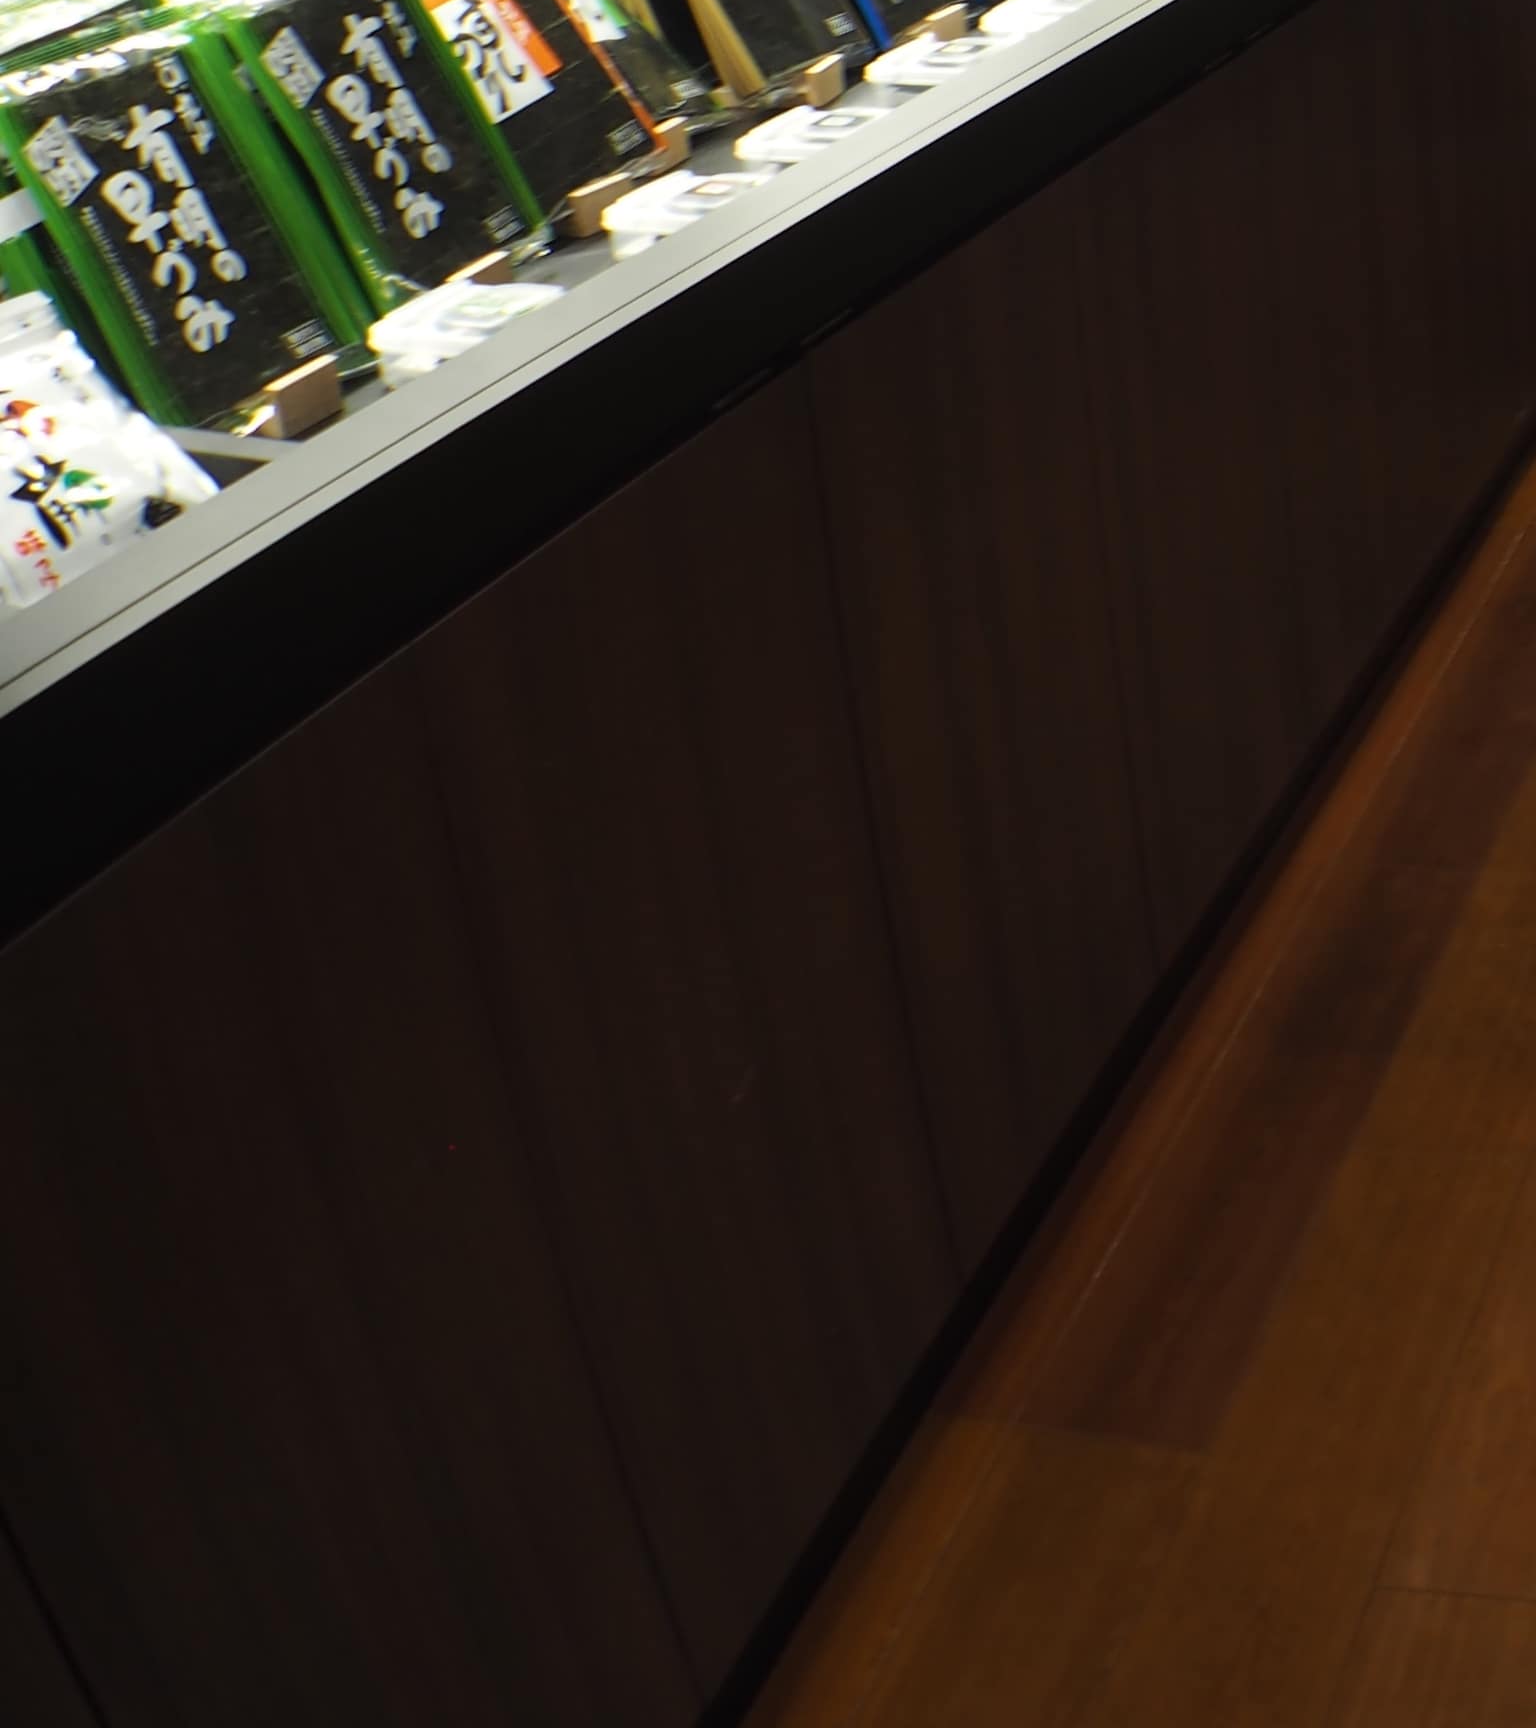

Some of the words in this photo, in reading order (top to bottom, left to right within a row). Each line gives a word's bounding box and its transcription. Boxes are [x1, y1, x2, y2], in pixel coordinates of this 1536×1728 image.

[326, 74, 444, 239] 早づみ
[340, 13, 453, 173] 有明の
[102, 170, 236, 352] 早づみ
[121, 104, 246, 282] 有明の
